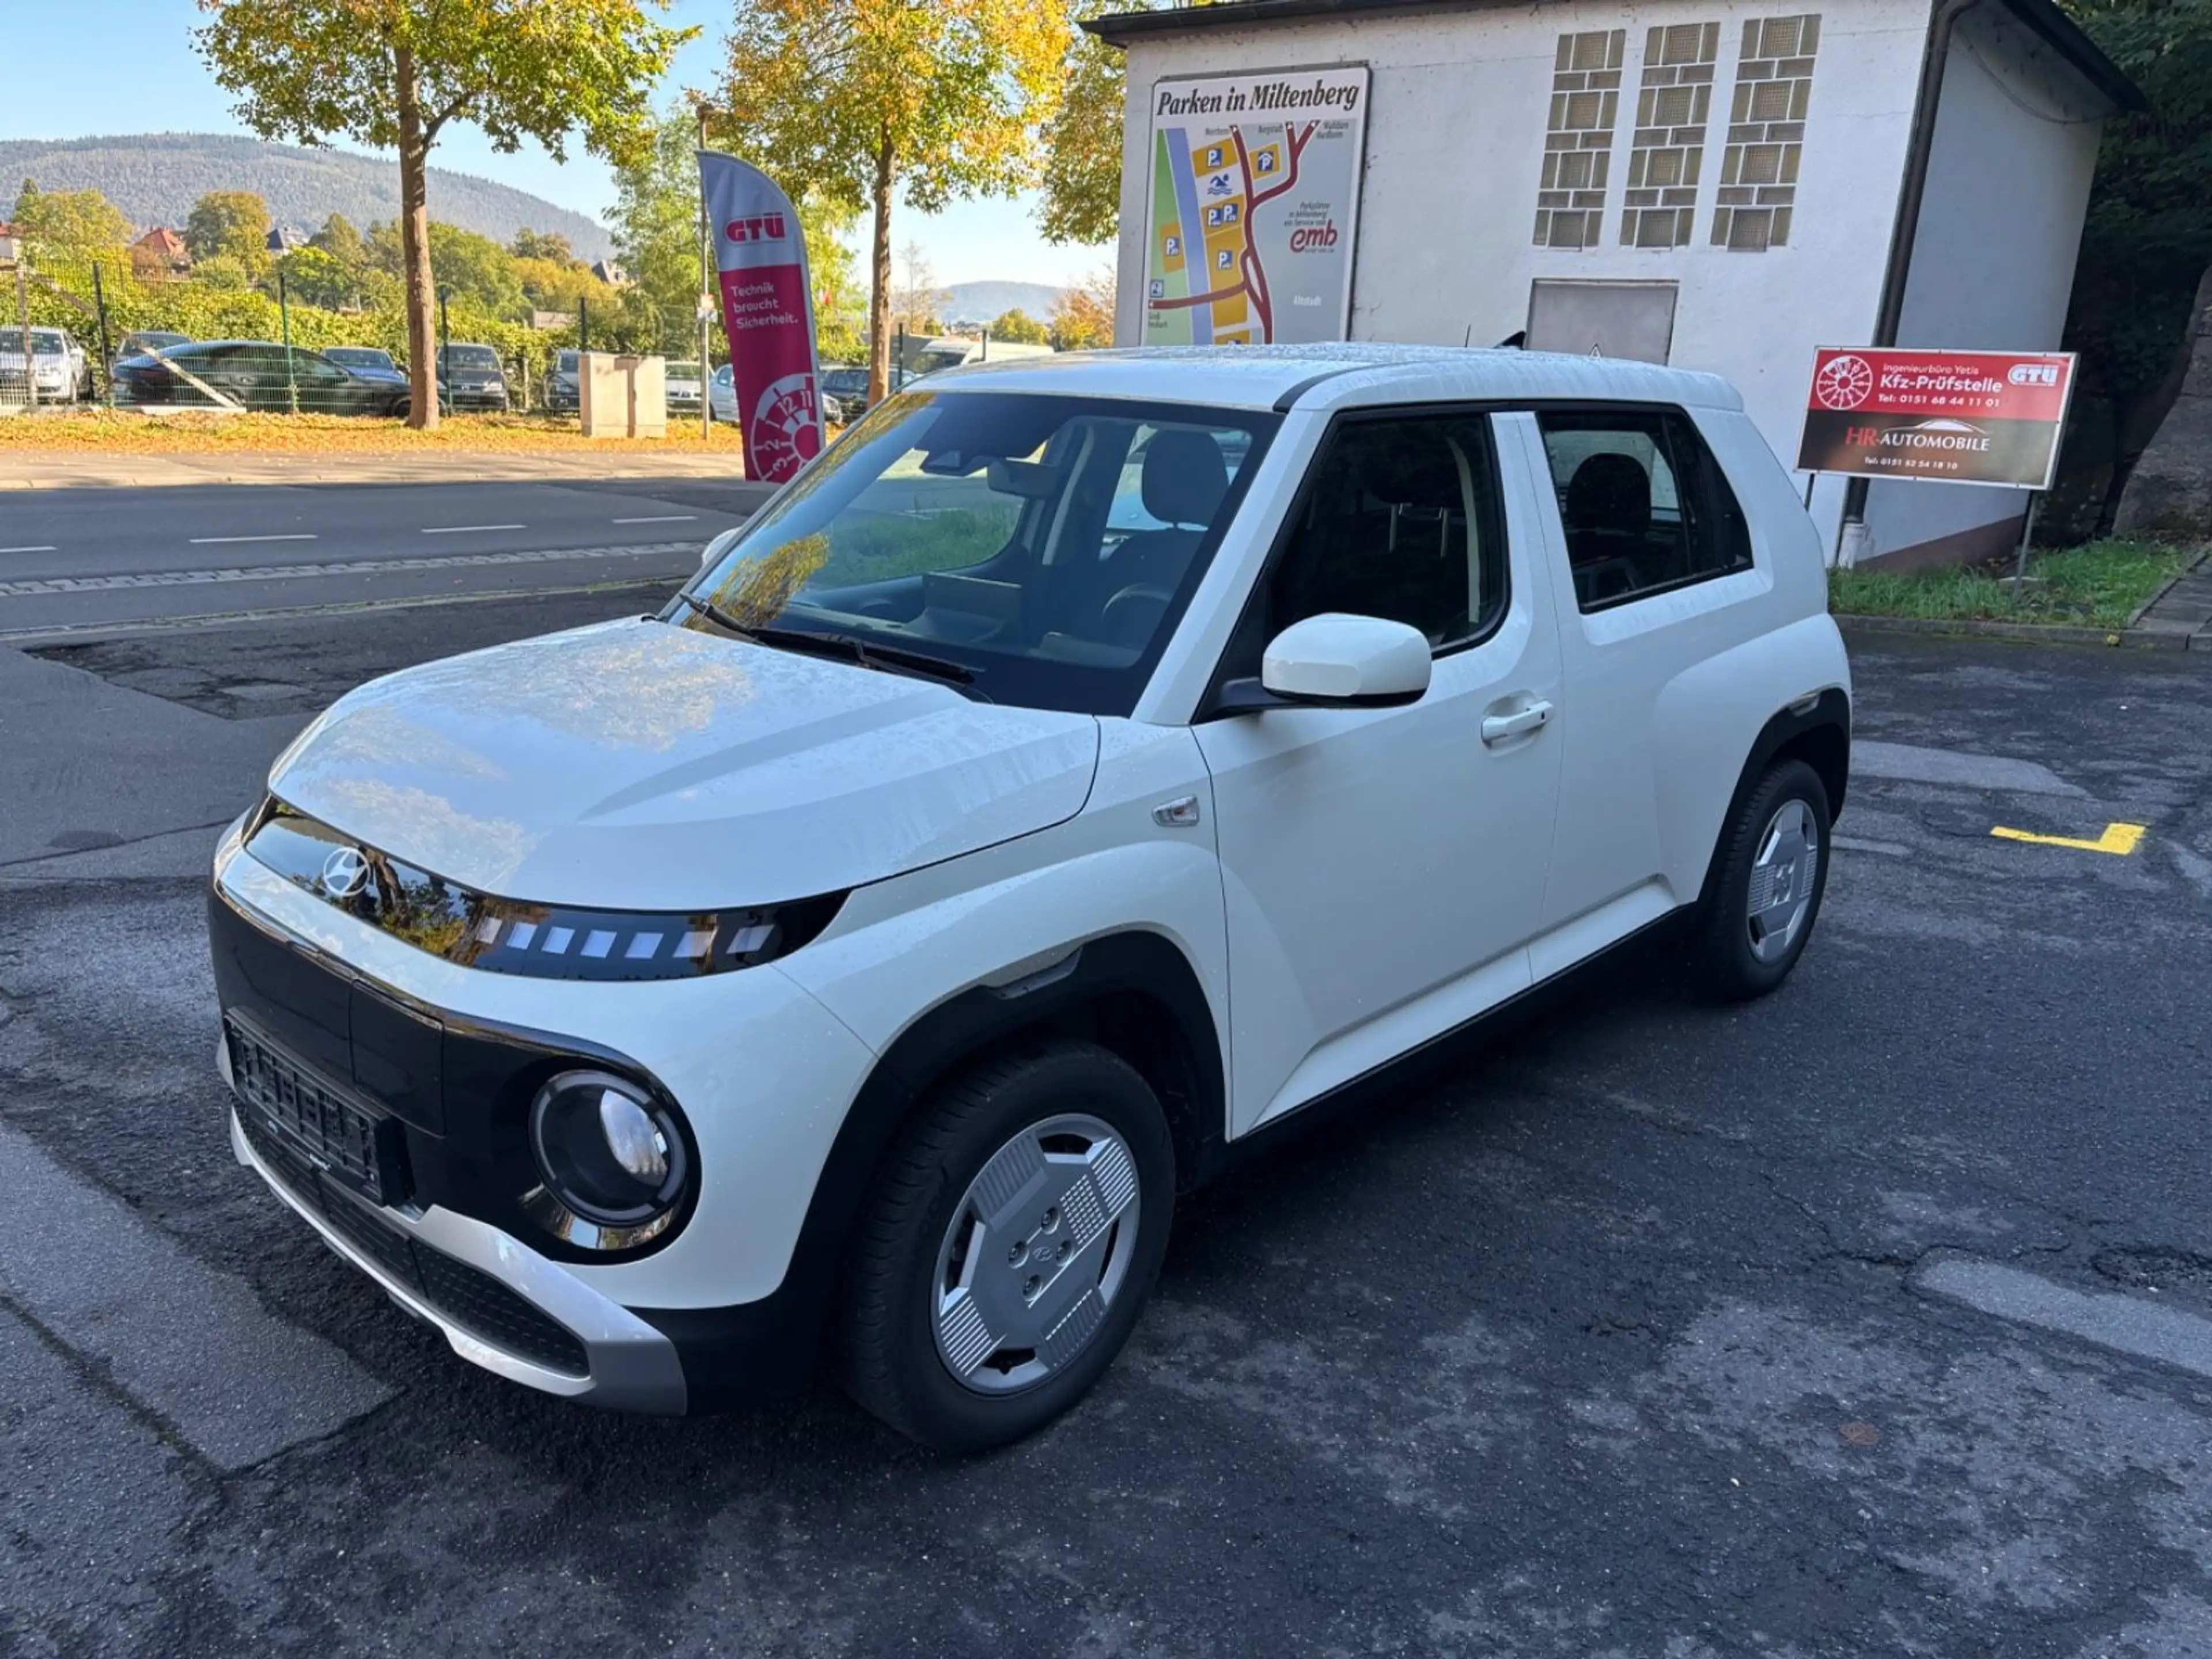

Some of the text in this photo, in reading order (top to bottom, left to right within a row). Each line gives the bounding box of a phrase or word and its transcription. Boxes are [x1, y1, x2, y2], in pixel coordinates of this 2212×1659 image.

[1157, 79, 1359, 115] Parken in Miltenberg
[726, 211, 785, 243] GTÜ
[1290, 219, 1338, 253] emb
[730, 282, 775, 297] Technik
[733, 298, 780, 313] braucht
[736, 312, 799, 329] Sicherheit.
[1883, 363, 1953, 375] Ingenieurbüro
[1880, 374, 2003, 393] Kfz-Prüfstelle
[1878, 393, 1896, 403] Tel:
[1899, 394, 1927, 404] 0151
[1949, 396, 1965, 406] 44
[1968, 397, 1981, 407] 11
[1984, 397, 2001, 407] 01
